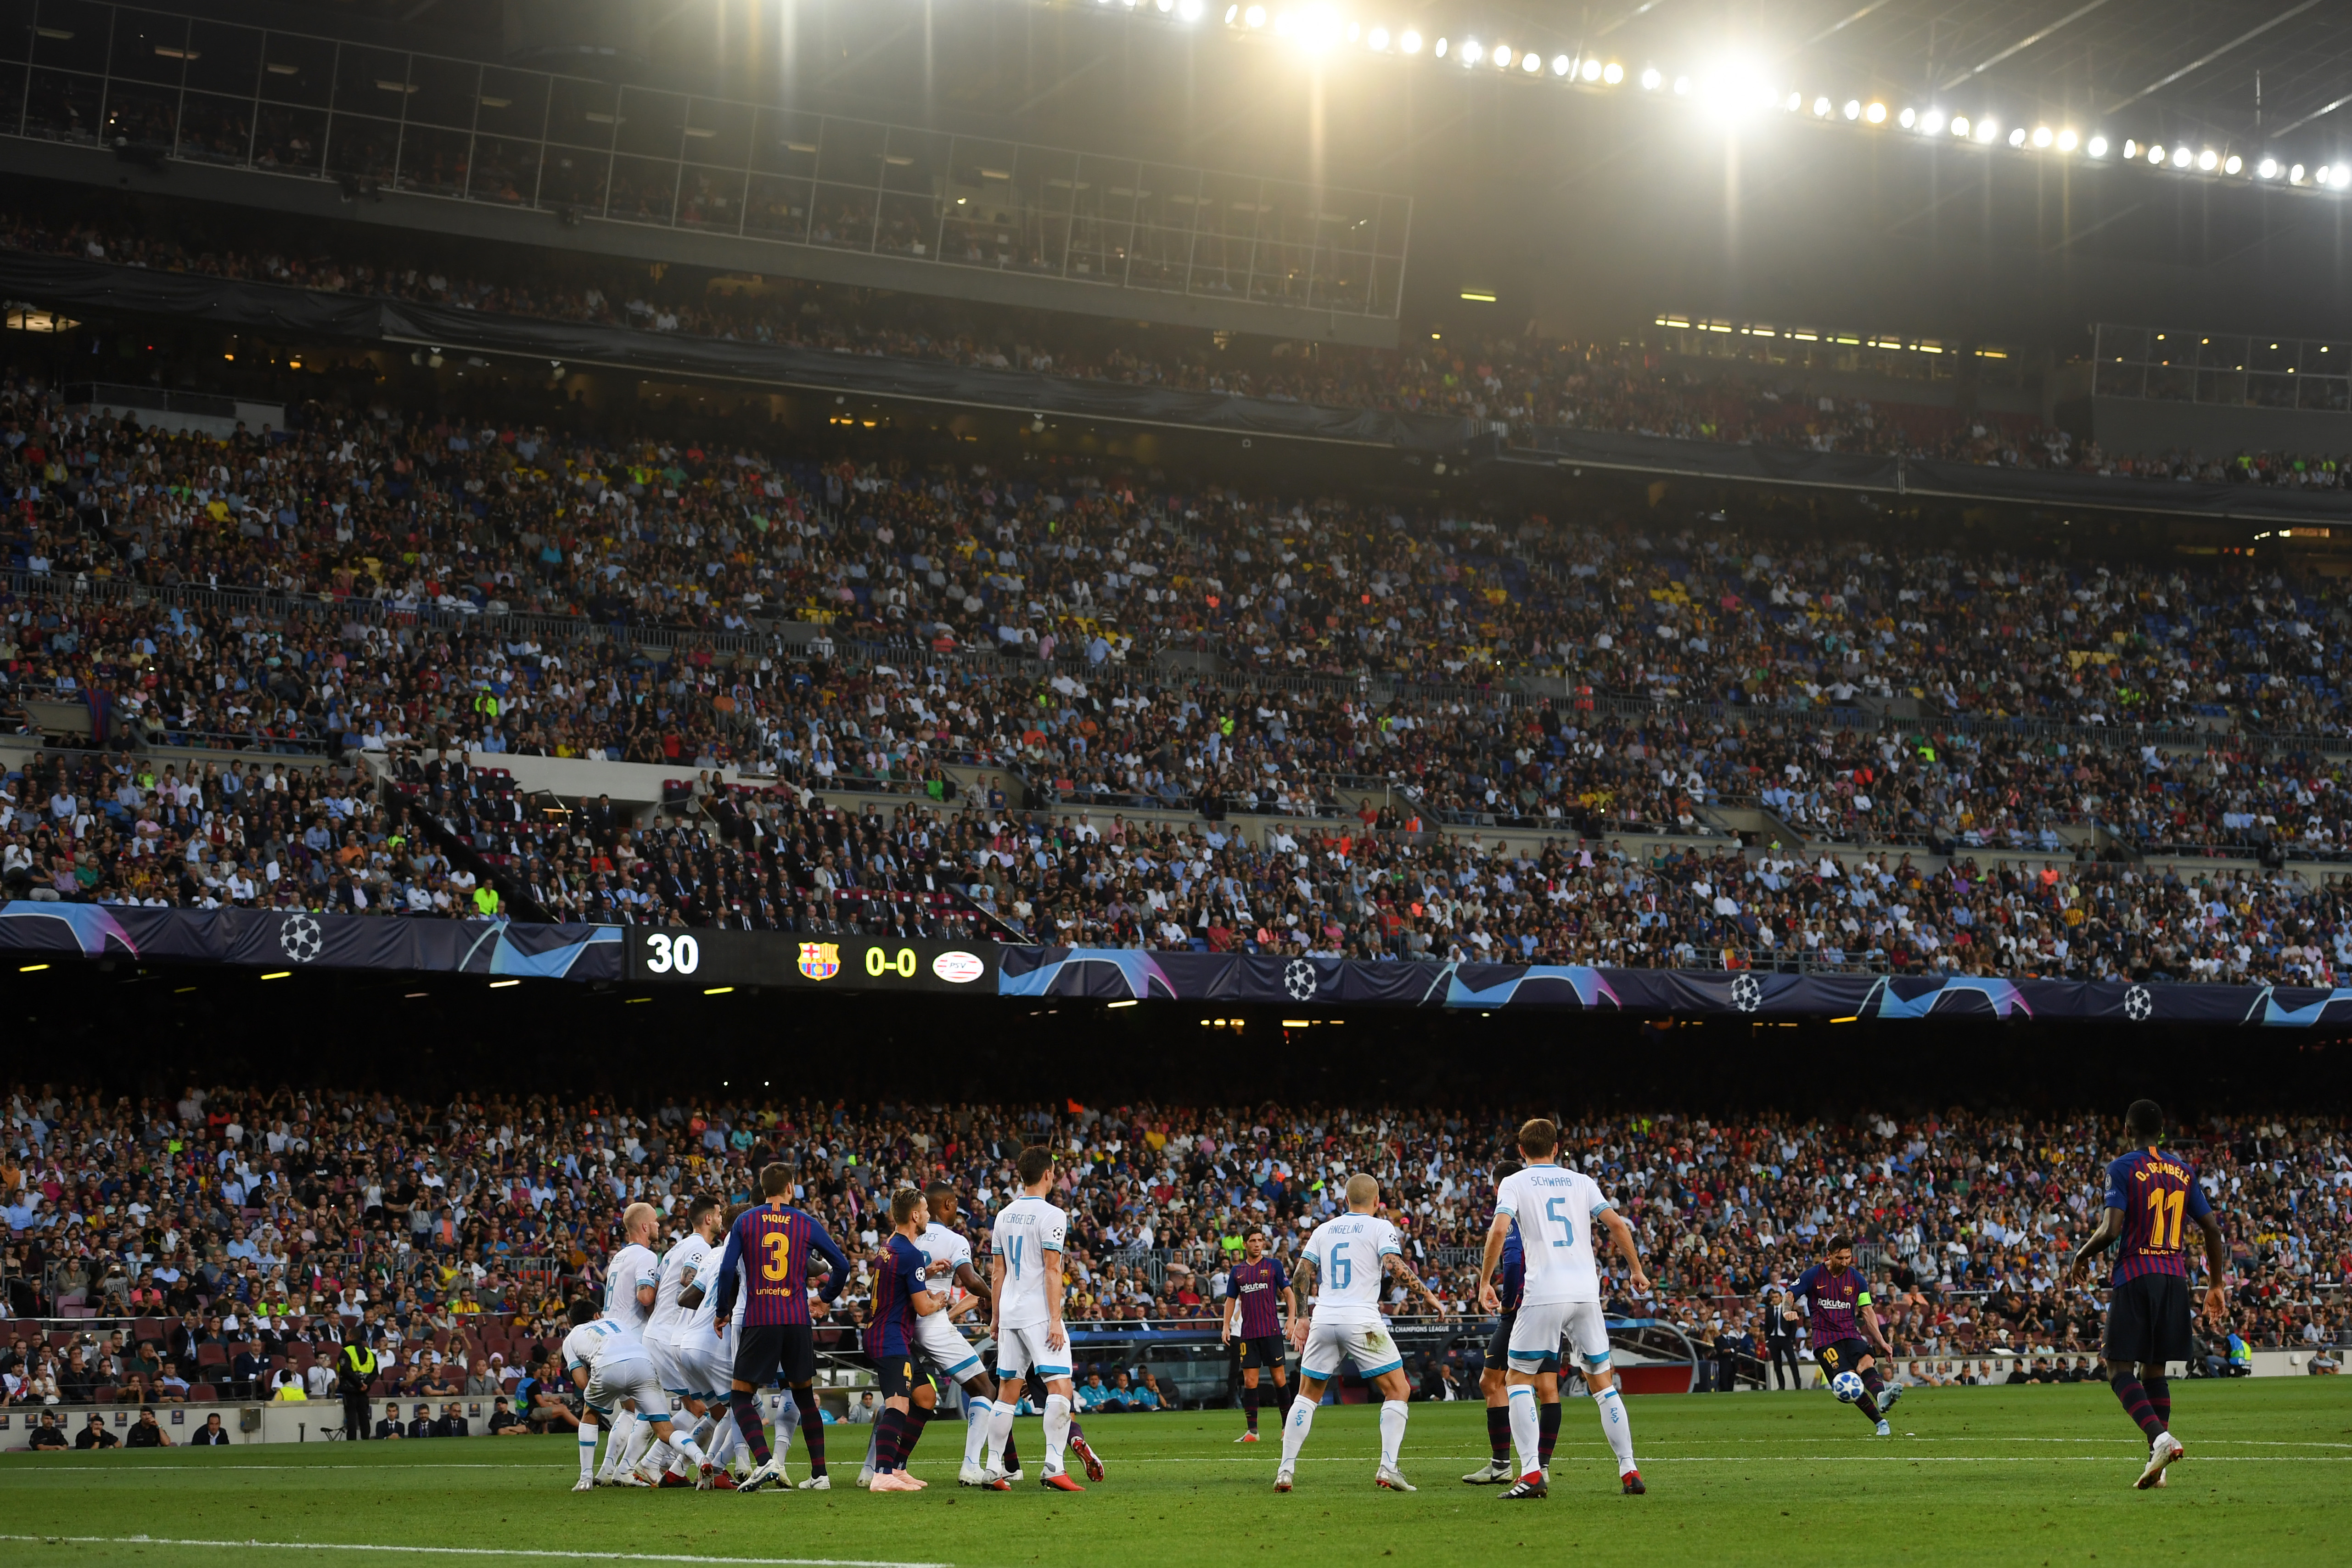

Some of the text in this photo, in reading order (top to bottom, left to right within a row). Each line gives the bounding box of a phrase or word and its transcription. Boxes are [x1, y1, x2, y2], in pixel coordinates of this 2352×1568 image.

[646, 933, 699, 975] 30
[865, 946, 916, 978] 0-0
[1531, 1176, 1572, 1187] SCHWAAB
[2135, 1162, 2190, 1186] O. DEMBÉLE
[762, 1214, 791, 1224] PIQUÉ
[1002, 1213, 1036, 1225] VIERGEVER
[1545, 1197, 1574, 1247] 5
[2148, 1187, 2185, 1250] 11
[1328, 1223, 1364, 1235] ANGELIÑO
[761, 1231, 789, 1281] 3
[1008, 1235, 1023, 1281] 4
[1330, 1242, 1351, 1290] 6
[603, 1271, 618, 1312] 8
[756, 1286, 780, 1295] unicef
[1240, 1282, 1268, 1293] Rakuten
[1817, 1298, 1851, 1309] Rakuten
[1823, 1347, 1839, 1364] 10
[903, 1361, 912, 1381] 4
[1295, 1409, 1307, 1427] PSV
[1611, 1407, 1619, 1424] PSV
